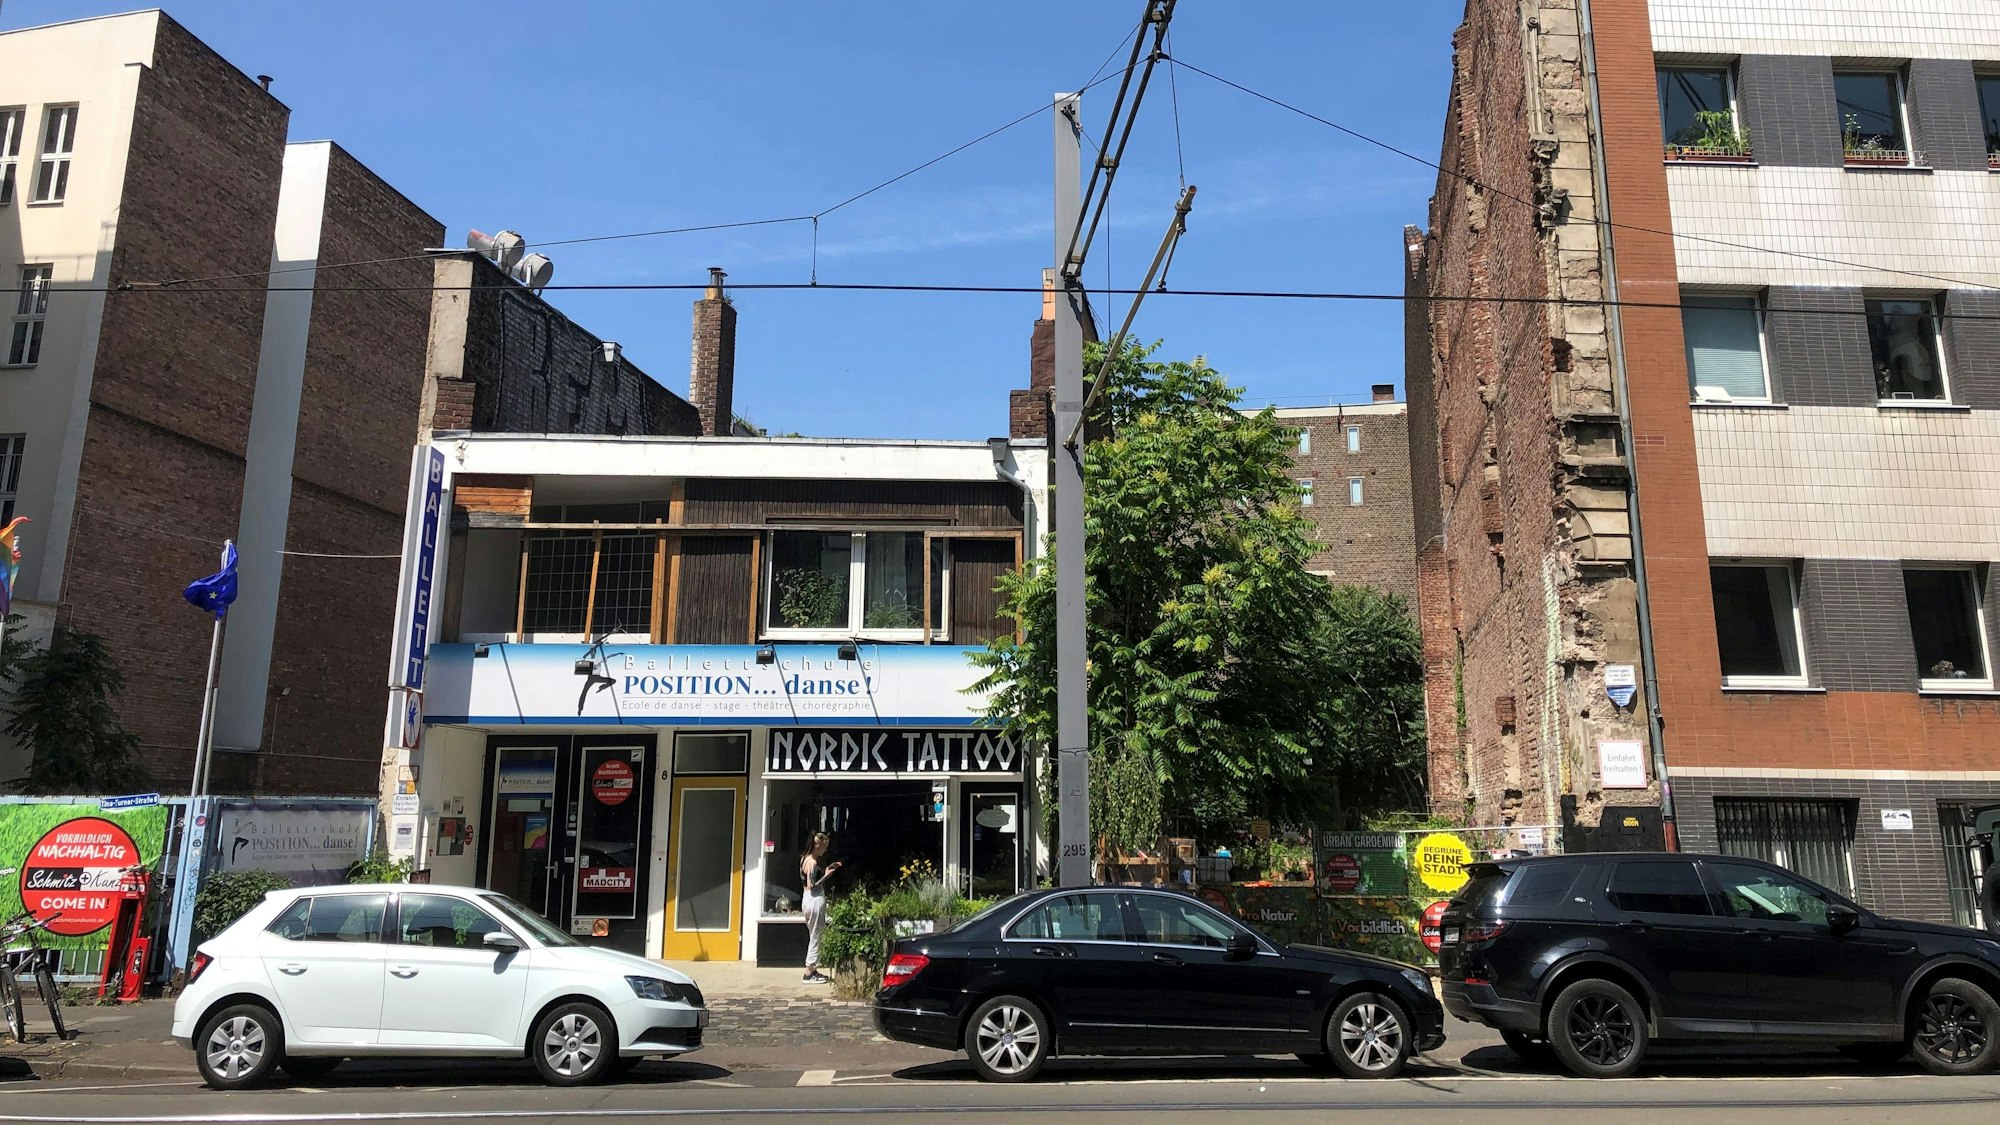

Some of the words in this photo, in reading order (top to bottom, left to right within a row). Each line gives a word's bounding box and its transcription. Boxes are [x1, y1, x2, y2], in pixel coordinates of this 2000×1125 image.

[411, 460, 441, 683] BALLETT
[622, 675, 777, 695] POSITION...
[654, 701, 667, 709] de
[671, 701, 701, 709] danse
[713, 702, 740, 712] stage
[753, 701, 790, 709] théâtre
[802, 701, 871, 712] chorégraphie
[772, 731, 888, 771] NORDIC
[902, 732, 1016, 772] TATTOO
[1607, 754, 1636, 762] Einfahrt
[661, 770, 668, 780] 8
[1603, 765, 1639, 773] freihalten
[56, 833, 113, 844] VORBILDLICH
[252, 836, 320, 851] POSITION...
[323, 835, 358, 849] danse!
[1323, 835, 1352, 847] URBAN
[1354, 835, 1404, 848] GARDENING
[37, 844, 126, 859] NACHHALTIG
[1063, 843, 1087, 857] 295
[1423, 846, 1463, 855] BEGRÜNE
[1423, 853, 1463, 866] DEINE
[1423, 864, 1463, 875] STADT
[27, 869, 79, 888] Schmitz
[586, 879, 628, 887] MADCITY
[40, 898, 86, 909] COME
[89, 898, 110, 909] IN!
[1239, 908, 1260, 921] Pro
[1260, 908, 1298, 922] Natur.
[1337, 919, 1406, 934] Vorbildlich
